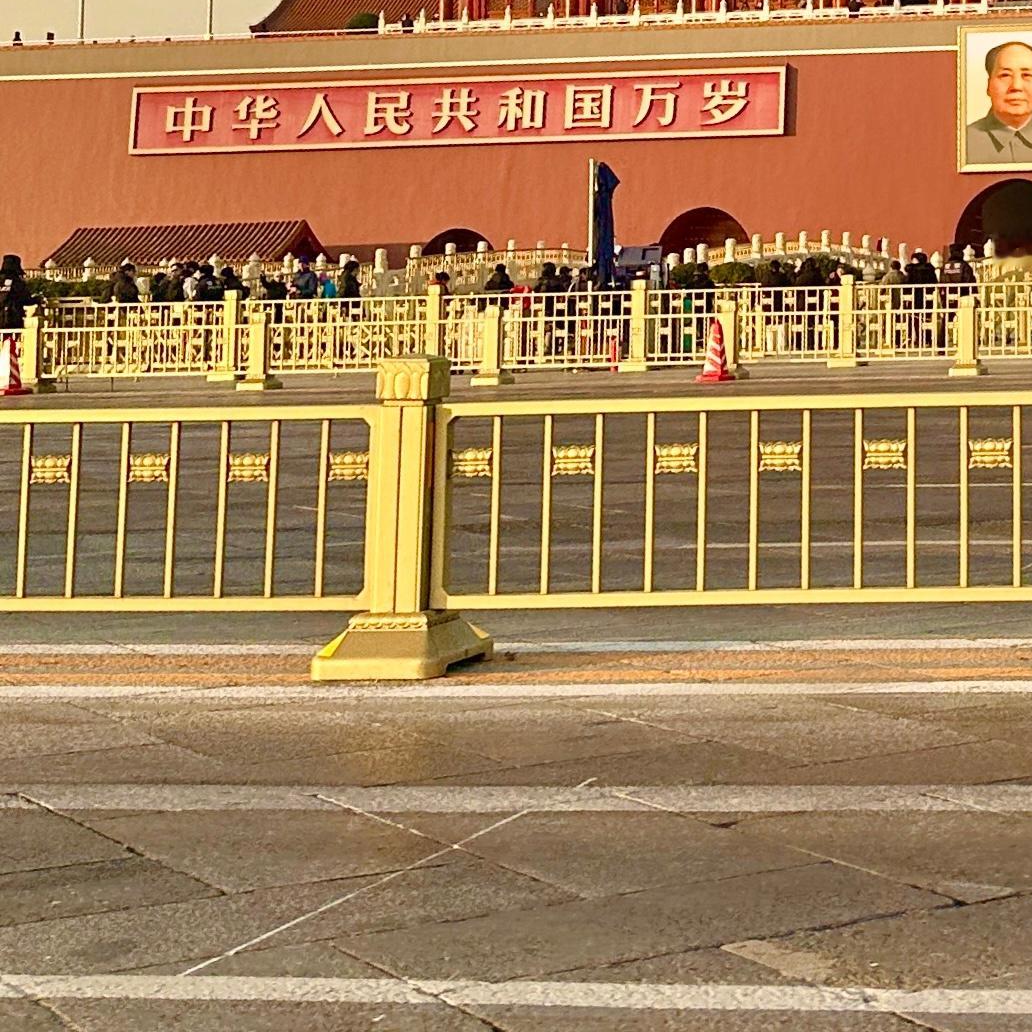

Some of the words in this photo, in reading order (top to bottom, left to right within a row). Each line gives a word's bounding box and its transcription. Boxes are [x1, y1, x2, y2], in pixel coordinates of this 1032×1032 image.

[165, 80, 749, 142] 中华人民共和国万岁
